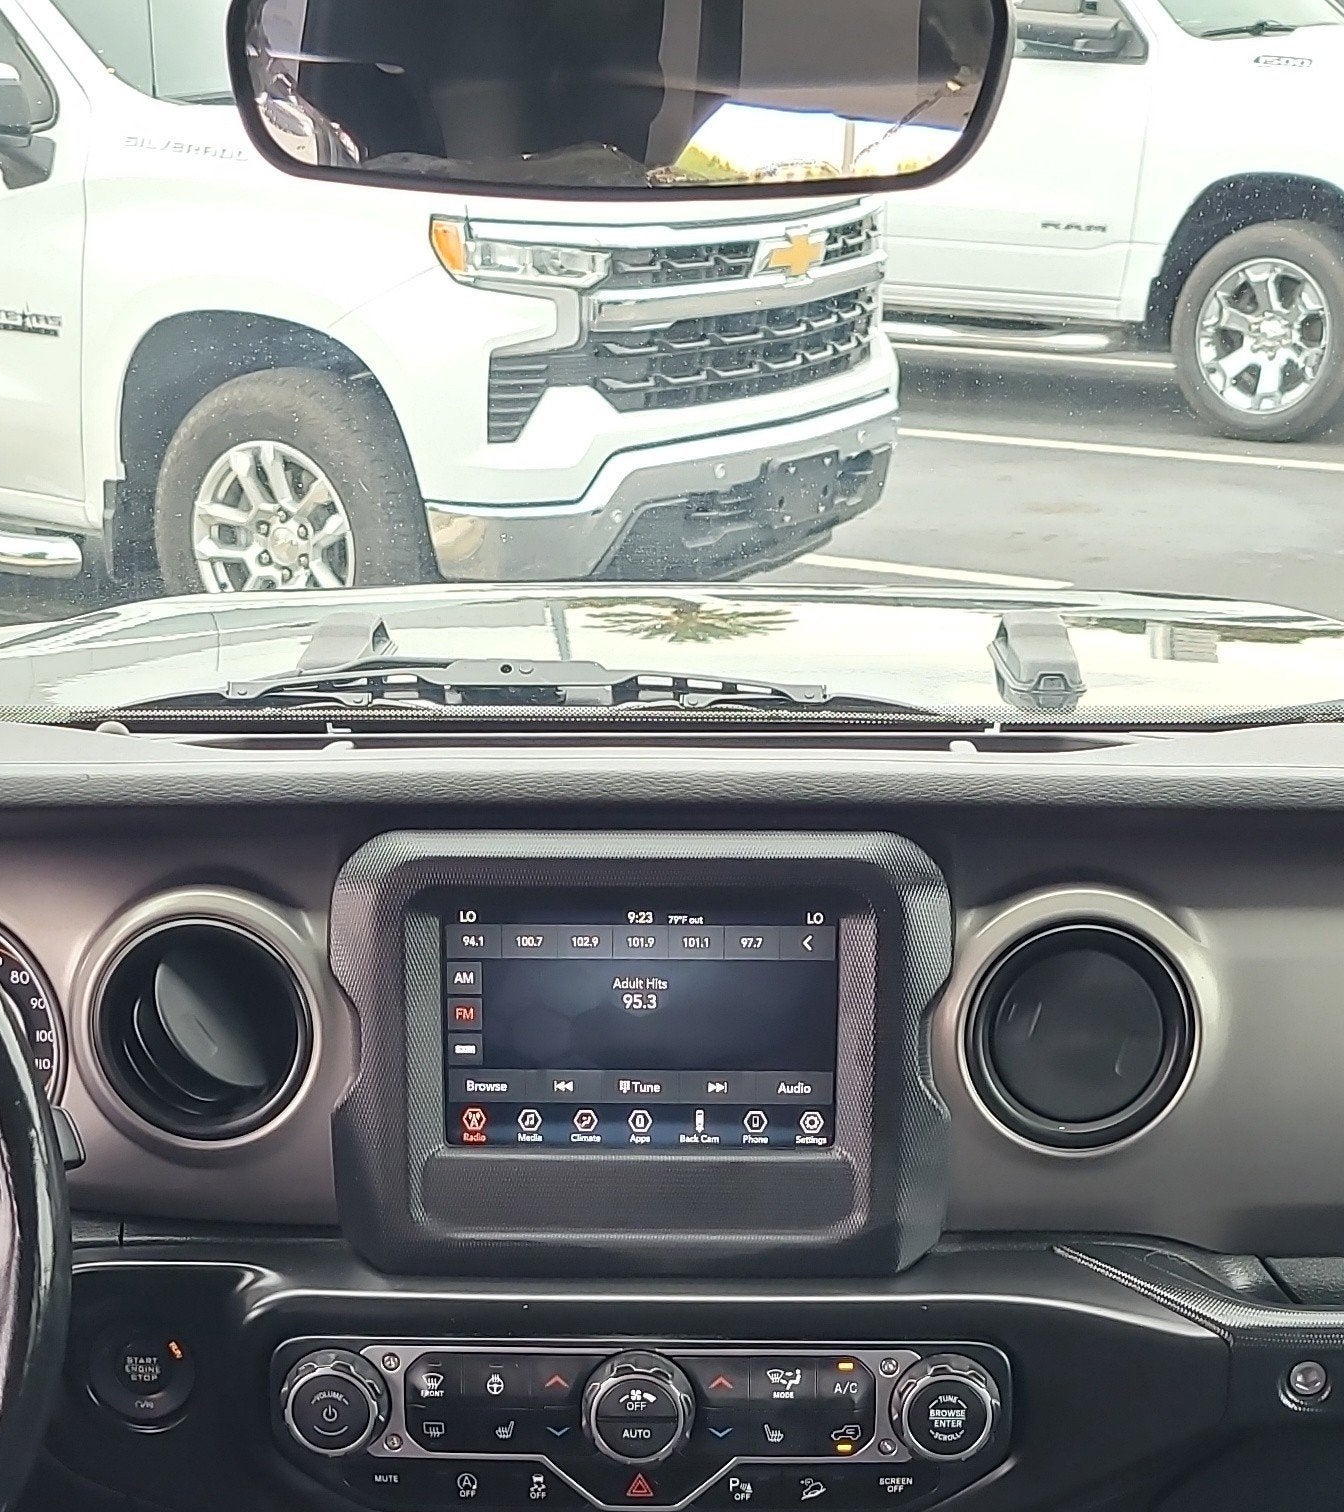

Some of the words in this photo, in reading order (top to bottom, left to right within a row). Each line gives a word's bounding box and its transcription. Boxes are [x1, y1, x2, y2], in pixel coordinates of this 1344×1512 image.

[1040, 221, 1107, 233] RAM
[459, 910, 477, 923] LO
[627, 911, 654, 924] 9:23
[807, 912, 824, 925] LO
[462, 936, 485, 947] 94.1
[515, 936, 543, 948] 100.7
[571, 936, 599, 948] 102.9
[627, 936, 655, 948] 101.9
[682, 937, 710, 948] 101.1
[740, 937, 763, 949] 97.7
[10, 971, 30, 985] 80
[454, 972, 474, 984] AM
[612, 977, 644, 990] Adult
[646, 977, 668, 990] Hits
[30, 997, 47, 1010] 90
[622, 994, 657, 1009] 95.3
[455, 1008, 474, 1020] FM
[35, 1030, 54, 1043] 100
[466, 1080, 508, 1092] Browse
[632, 1082, 661, 1093] Tune
[777, 1082, 812, 1094] Audio
[463, 1133, 487, 1142] Radio
[517, 1133, 543, 1142] Media
[570, 1134, 601, 1142] Climate
[629, 1135, 651, 1144] Apps
[679, 1135, 700, 1143] Back
[700, 1135, 720, 1143] Cam
[742, 1135, 769, 1144] Phone
[795, 1136, 827, 1145] Settings
[126, 1356, 158, 1365] START
[131, 1374, 158, 1382] STOP
[834, 1381, 858, 1395] A/C
[314, 1391, 344, 1401] VOLUME
[420, 1389, 444, 1398] FRONT
[773, 1391, 795, 1399] MODE
[938, 1395, 959, 1403] TUNE
[626, 1402, 647, 1411] OFF
[929, 1409, 966, 1417] BROWSE
[934, 1419, 963, 1428] ENTER
[622, 1428, 651, 1439] AUTO
[933, 1432, 960, 1442] SCROLL
[374, 1474, 399, 1483] MUTE
[879, 1477, 913, 1485] SCREEN
[459, 1490, 476, 1498] OFF
[530, 1491, 546, 1499] OFF
[734, 1492, 751, 1501] OFF
